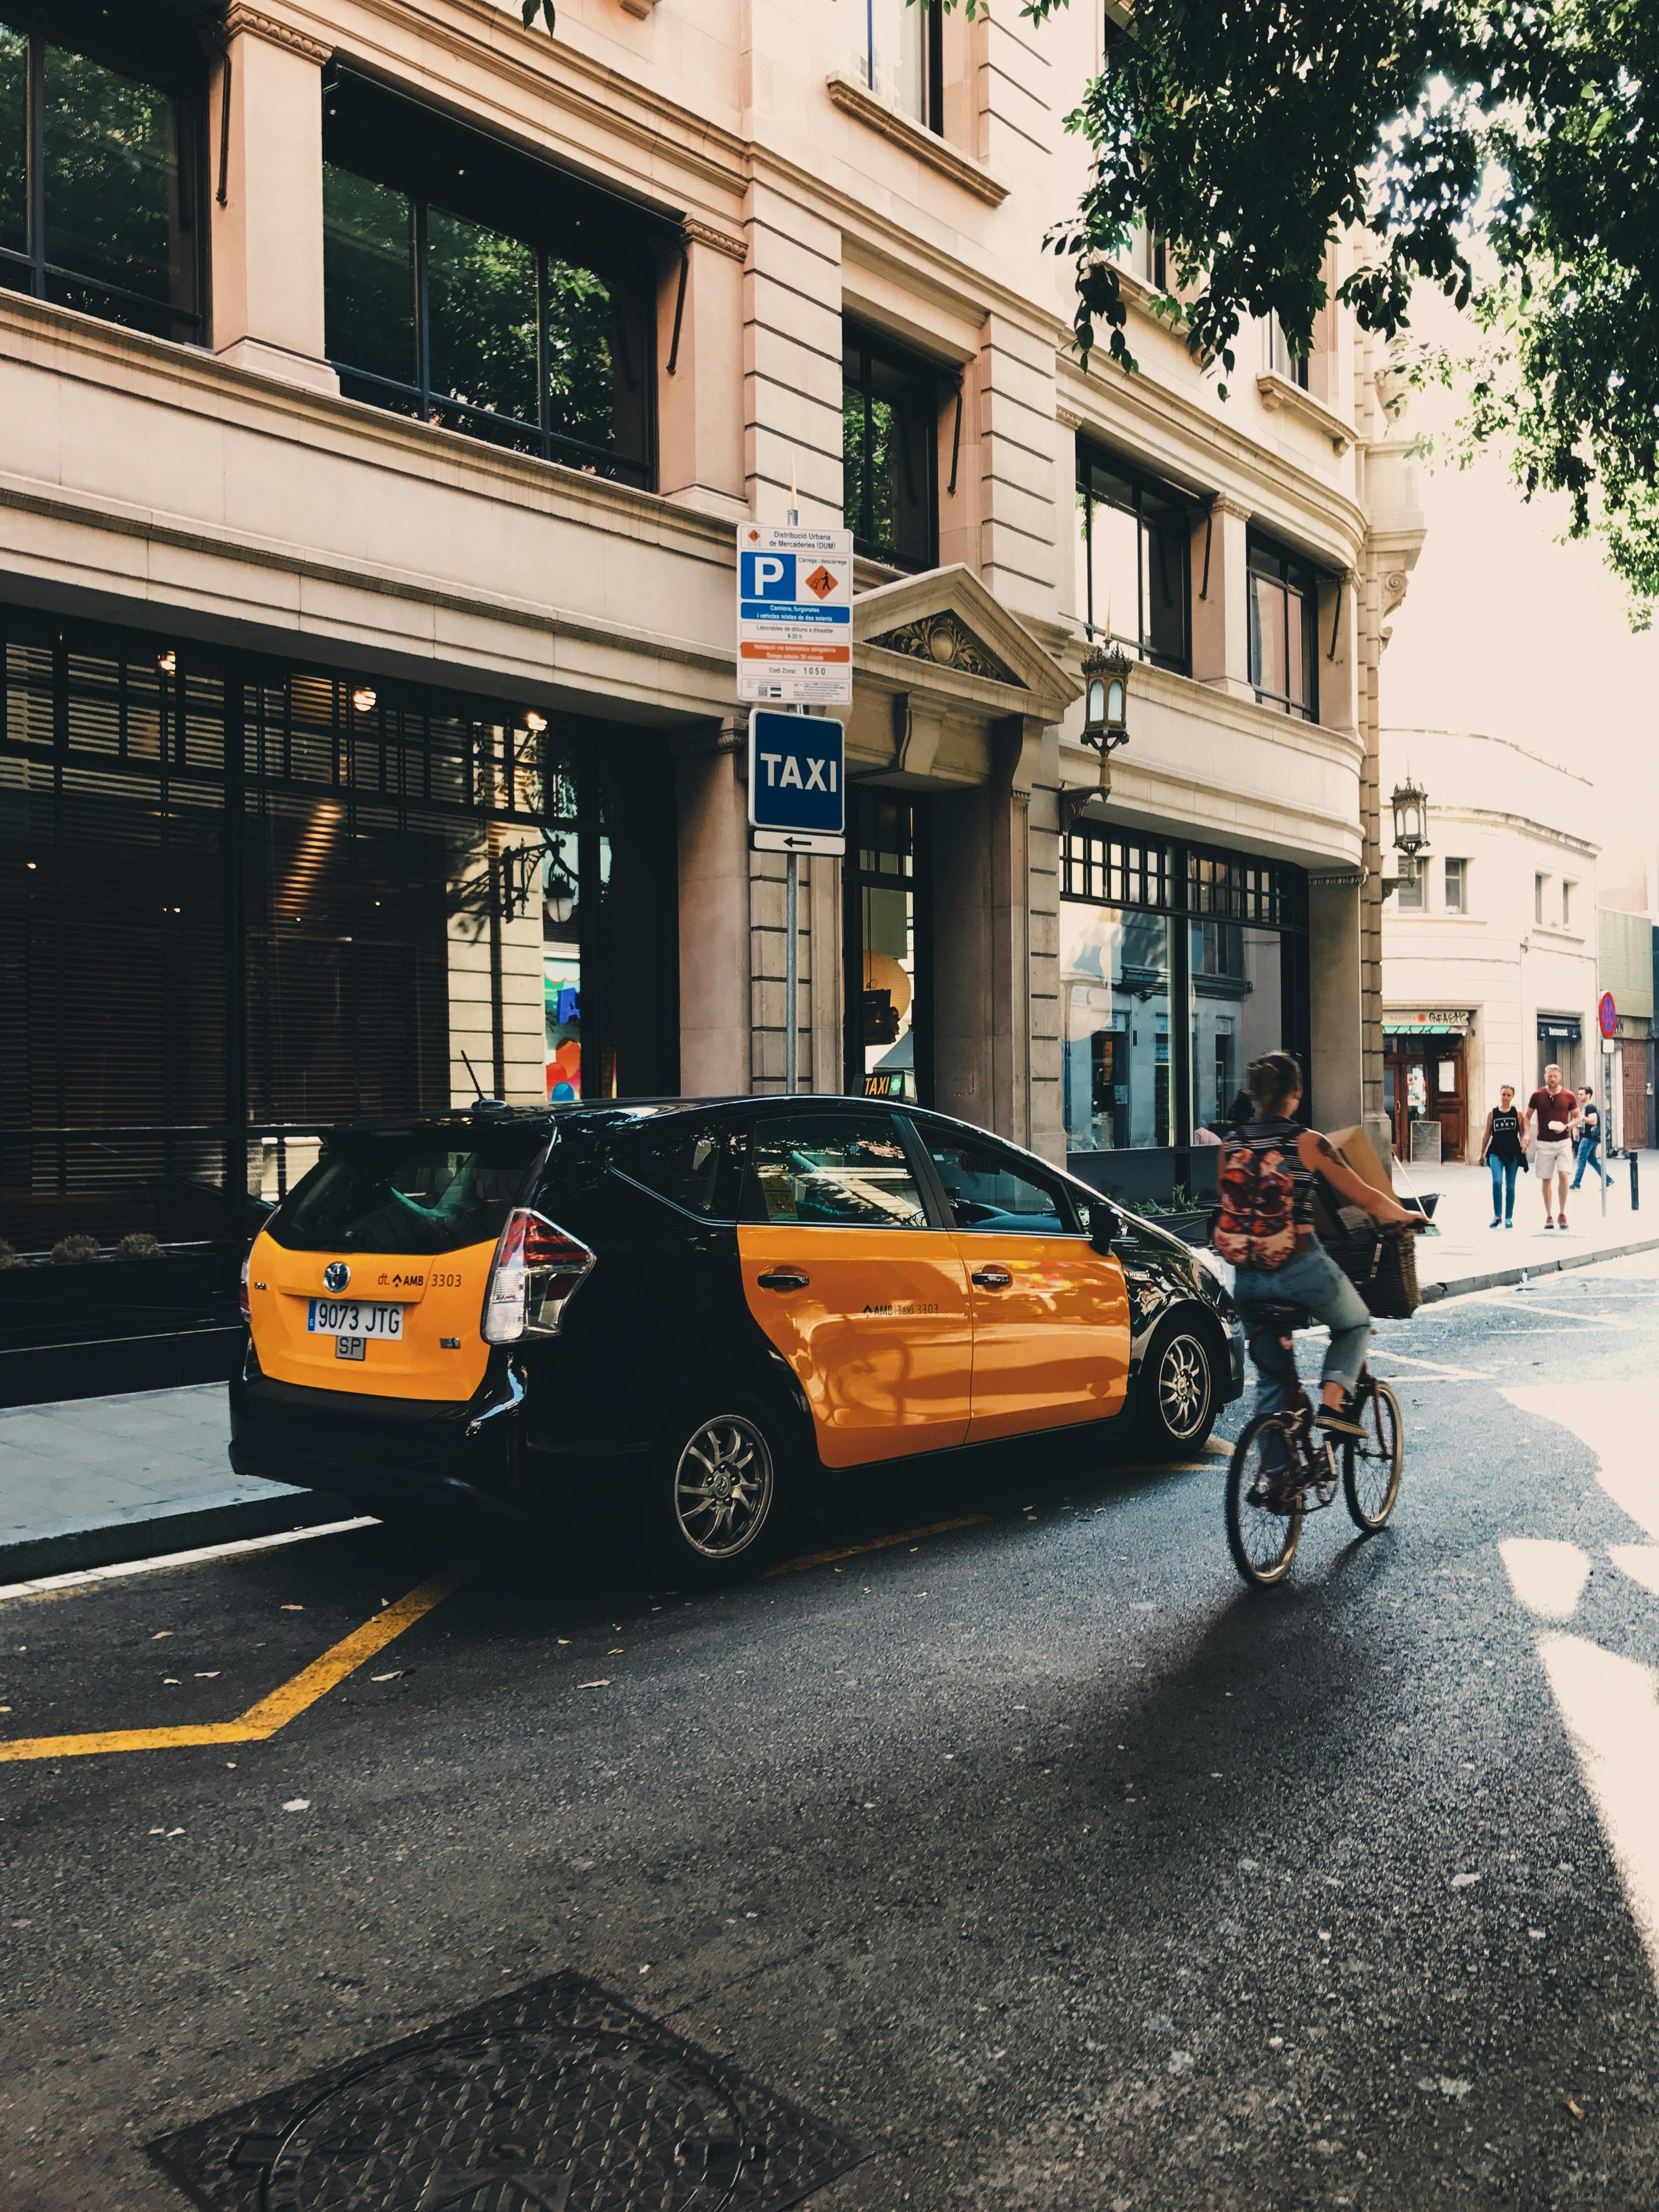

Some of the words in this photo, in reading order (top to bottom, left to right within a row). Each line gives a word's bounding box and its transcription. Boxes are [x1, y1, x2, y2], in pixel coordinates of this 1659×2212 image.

[774, 531, 807, 539] Distribució
[755, 557, 784, 596] P
[804, 667, 826, 675] 1050
[760, 753, 837, 792] TAXI
[865, 1076, 890, 1096] TAXI
[403, 1275, 424, 1286] AMB
[431, 1274, 462, 1287] 3303
[917, 1304, 939, 1314] 3303
[319, 1303, 359, 1330] 9073
[365, 1307, 400, 1334] JTG
[339, 1337, 361, 1355] SP
